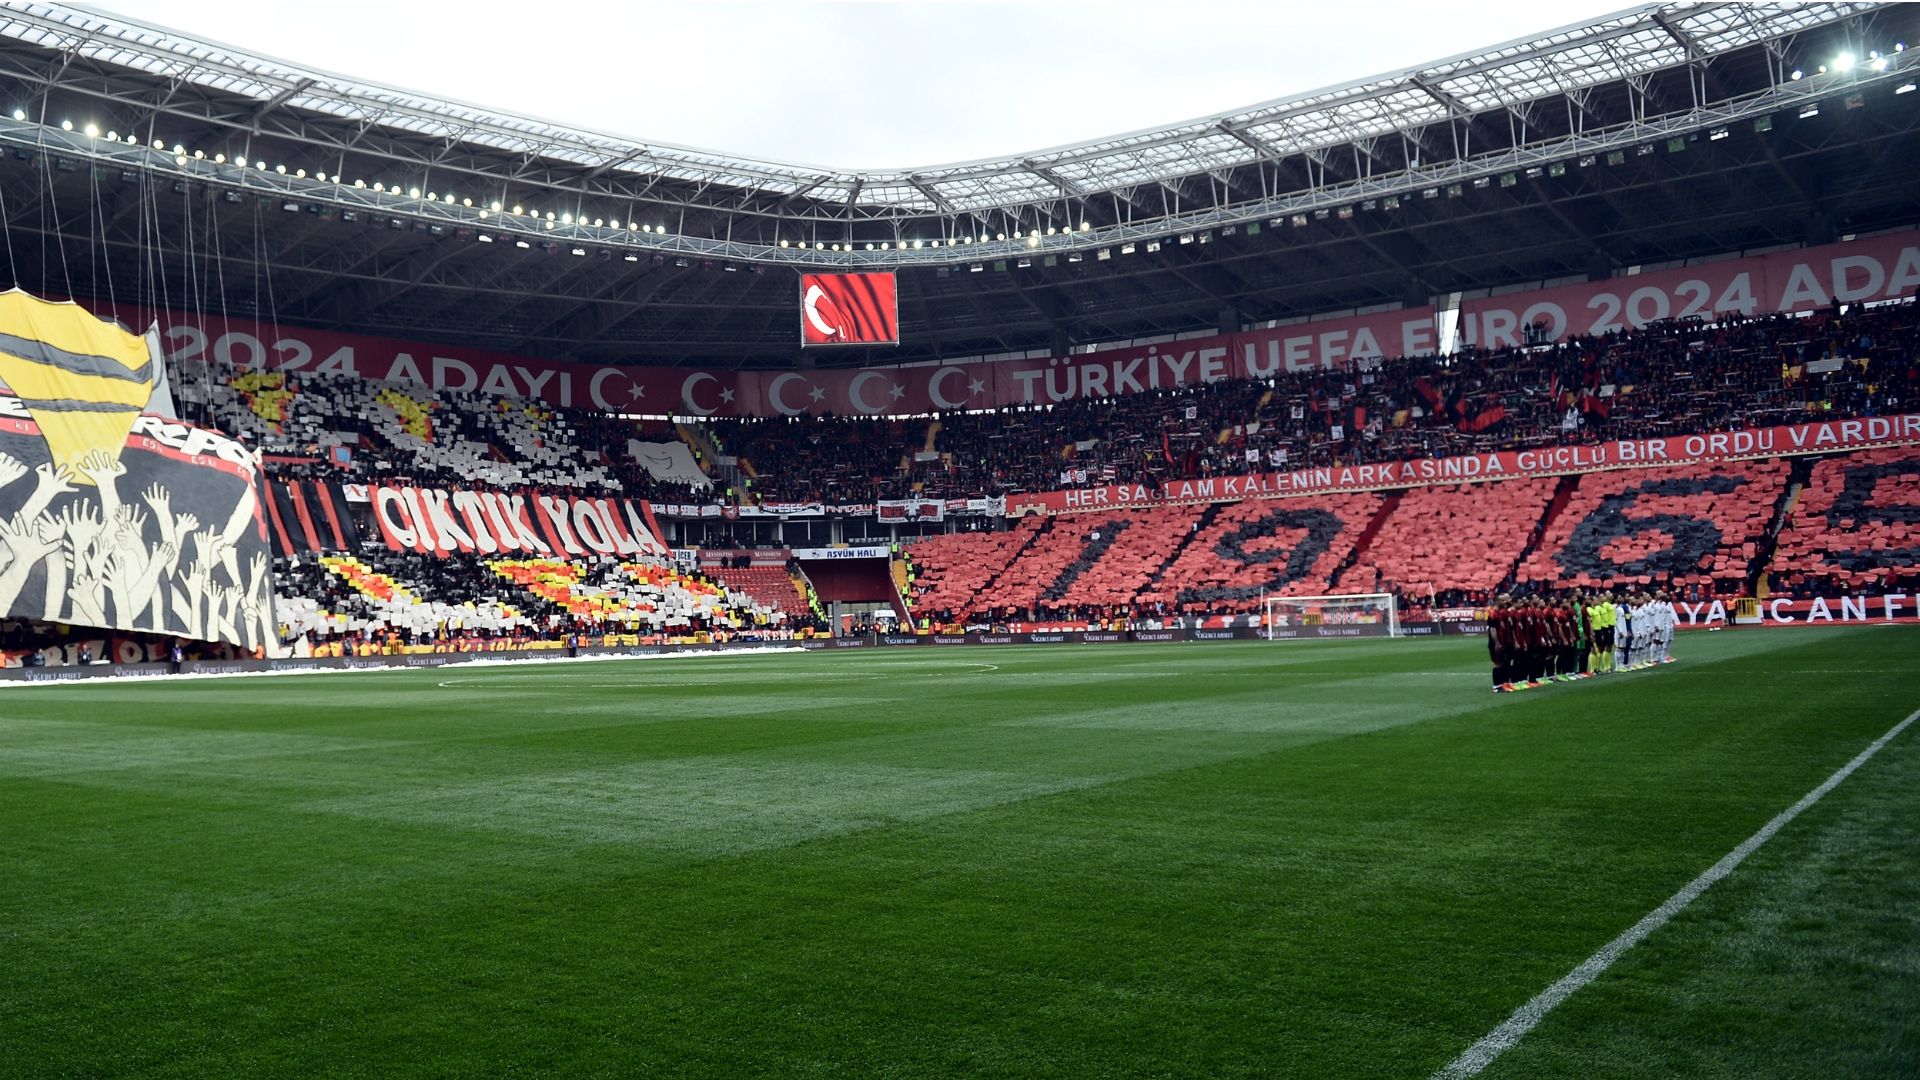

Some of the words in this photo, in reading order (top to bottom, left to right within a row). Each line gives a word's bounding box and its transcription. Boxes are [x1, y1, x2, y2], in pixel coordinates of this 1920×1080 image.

[163, 326, 360, 377] 2024
[384, 354, 571, 406] ADAYI
[1013, 346, 1229, 402] TÜRKİYE
[1245, 328, 1383, 378] UEFA
[1587, 272, 1757, 337] 2024
[1065, 488, 1109, 507] HER
[1686, 429, 1774, 456] ORDU
[538, 495, 666, 555] YOLA
[826, 546, 854, 558] ASYÜN
[1771, 595, 1867, 624] CAN
